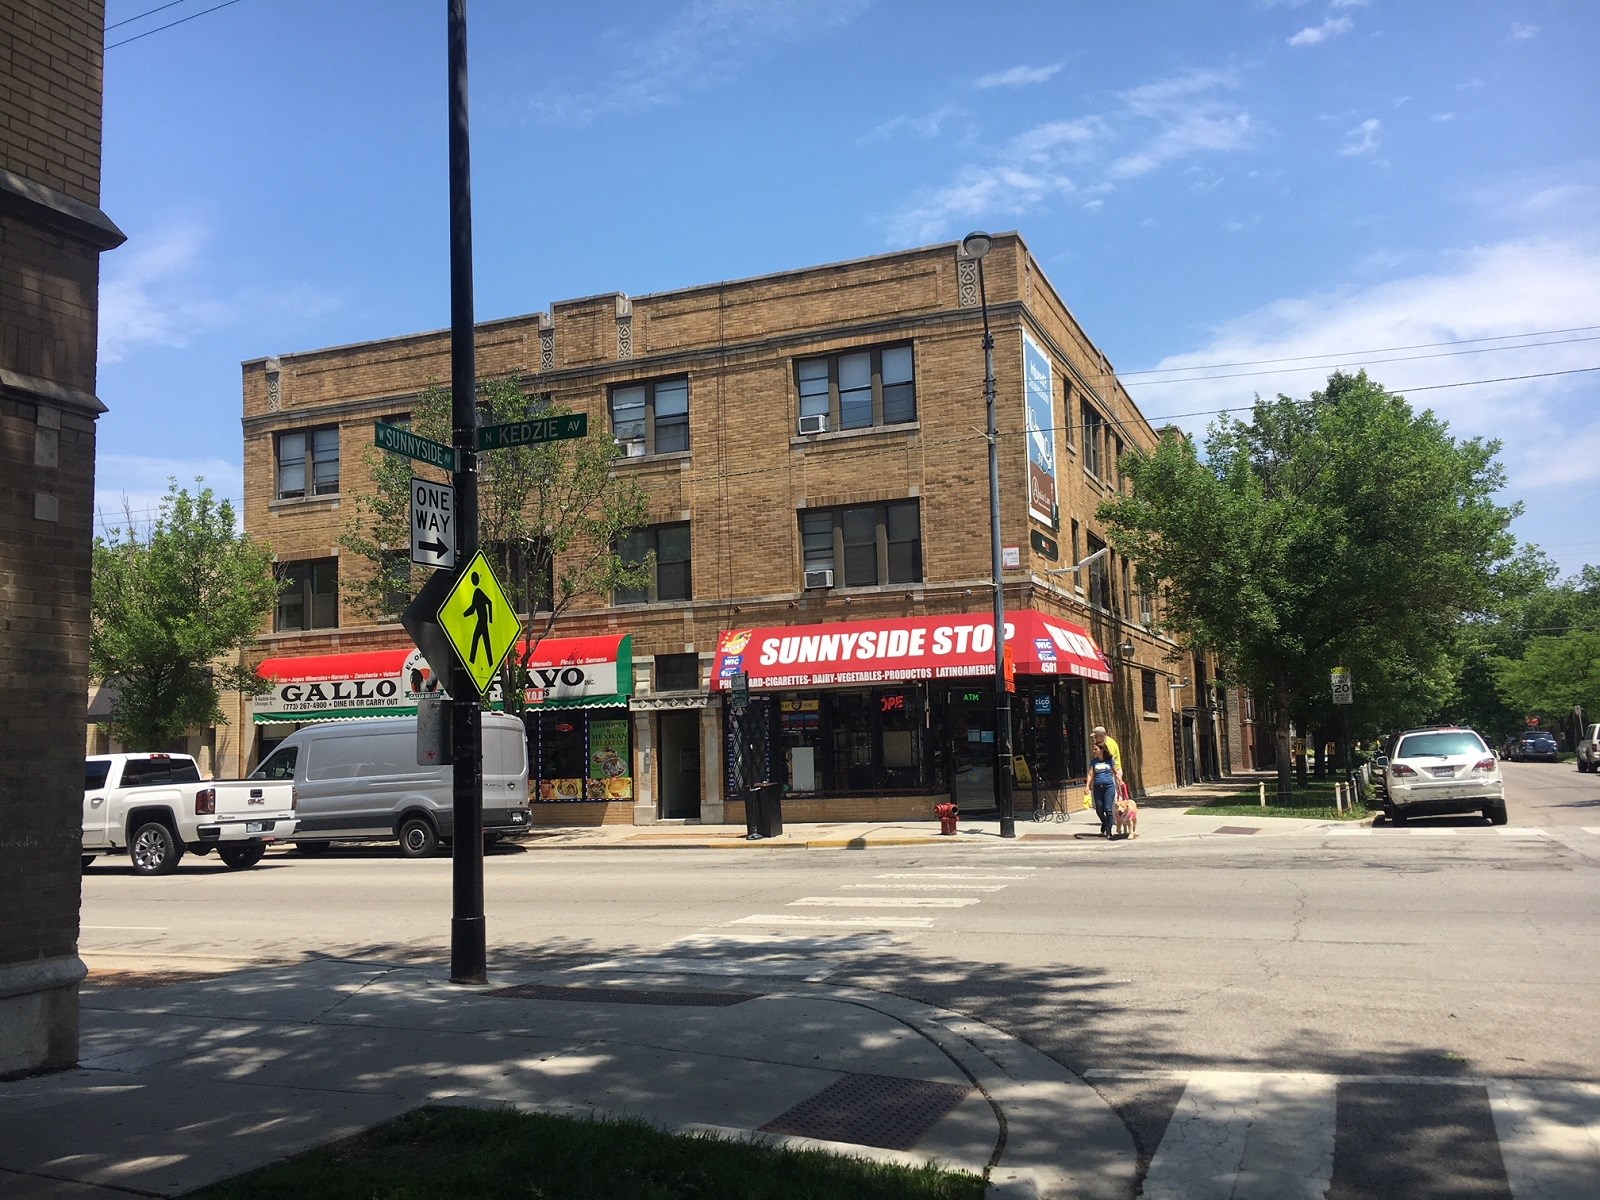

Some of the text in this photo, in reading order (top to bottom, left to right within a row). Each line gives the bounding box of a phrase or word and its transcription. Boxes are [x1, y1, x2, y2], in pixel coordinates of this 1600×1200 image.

[485, 420, 580, 444] N KEDZIE AV
[386, 428, 443, 465] SUNNYSIDE
[416, 486, 450, 511] ONE
[415, 509, 450, 534] WAY
[760, 628, 927, 665] SUNNYSIDE
[932, 622, 1015, 655] STOP
[1041, 662, 1057, 673] 4501
[281, 680, 397, 703] GALLO
[1334, 684, 1349, 693] 20
[300, 701, 327, 709] 267-4900
[365, 698, 385, 706] CARRY
[386, 698, 398, 706] OUT
[247, 798, 265, 806] GMC
